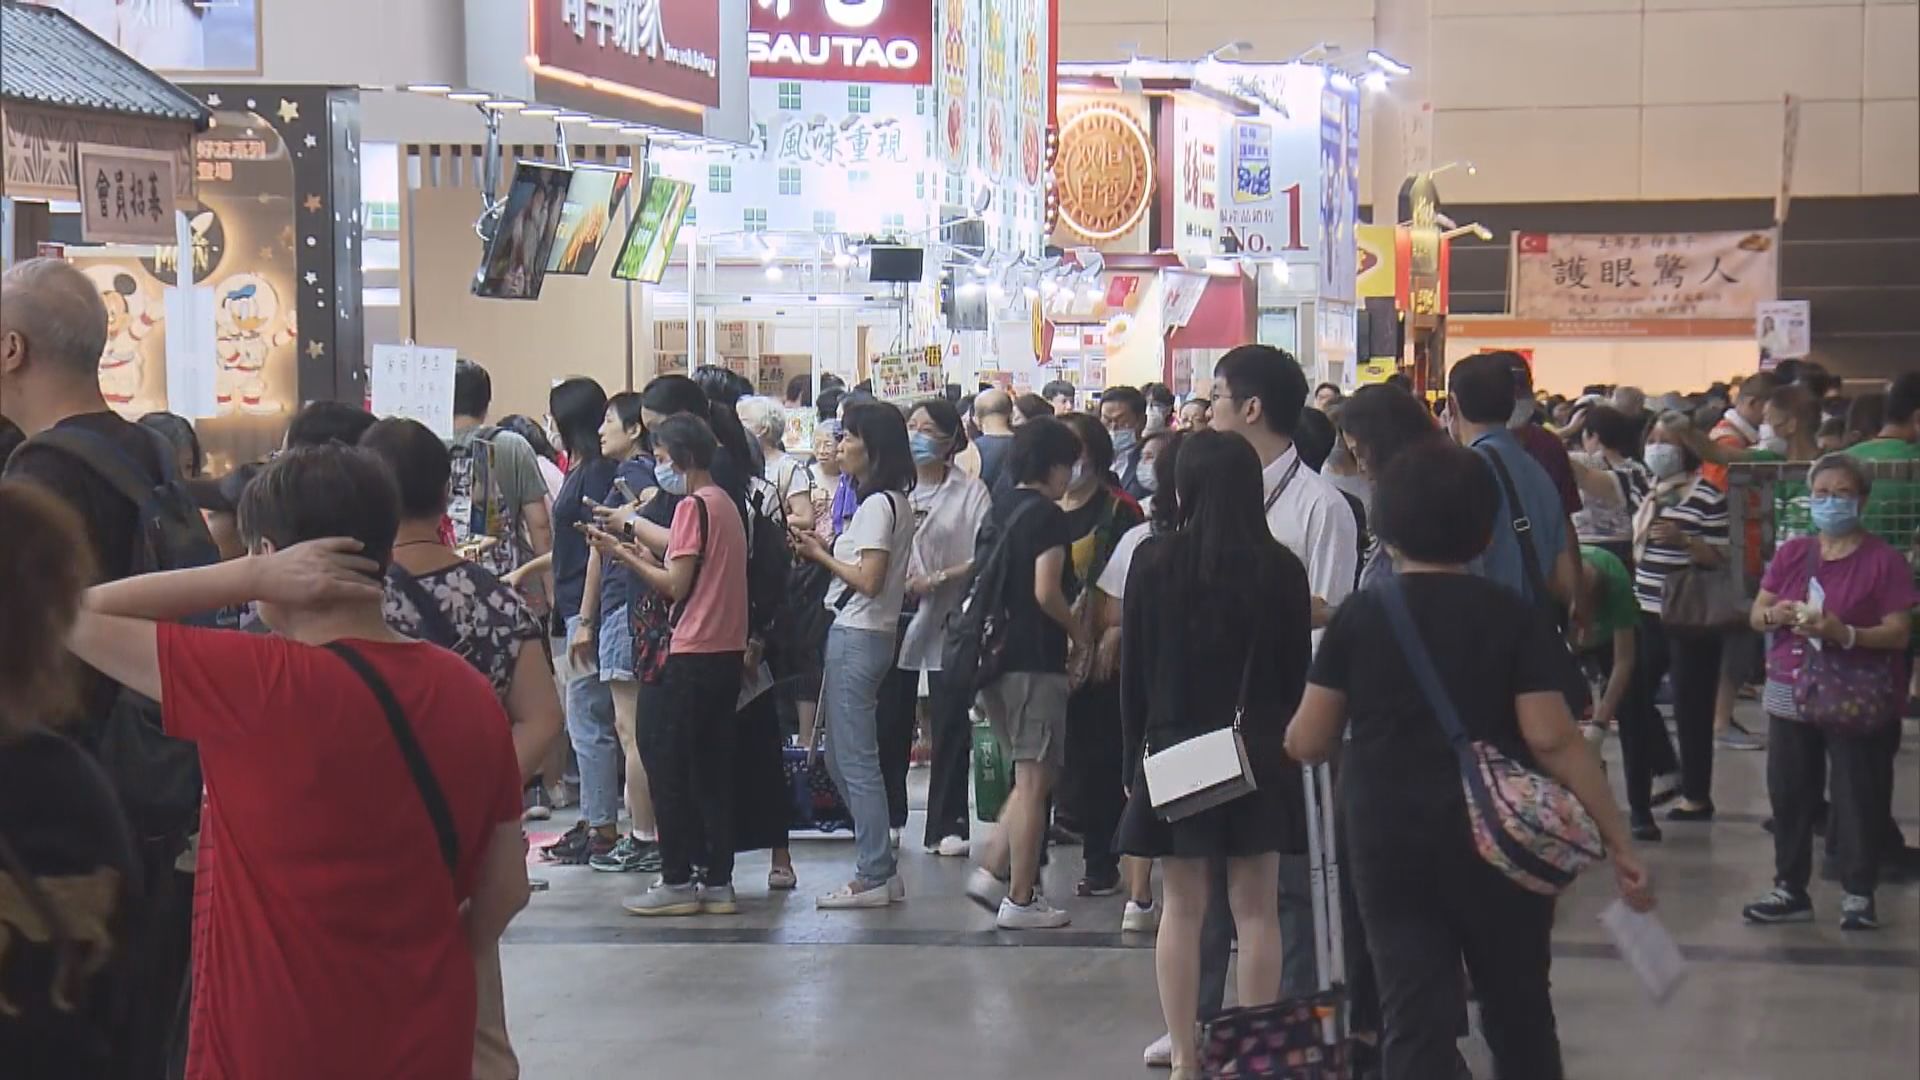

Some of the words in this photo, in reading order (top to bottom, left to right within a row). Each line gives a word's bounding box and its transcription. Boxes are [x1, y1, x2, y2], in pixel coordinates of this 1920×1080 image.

[778, 122, 908, 167] 風味重現
[96, 168, 163, 223] 會員招募
[1280, 183, 1309, 251] 1
[1551, 255, 1741, 289] 護眼驚人
